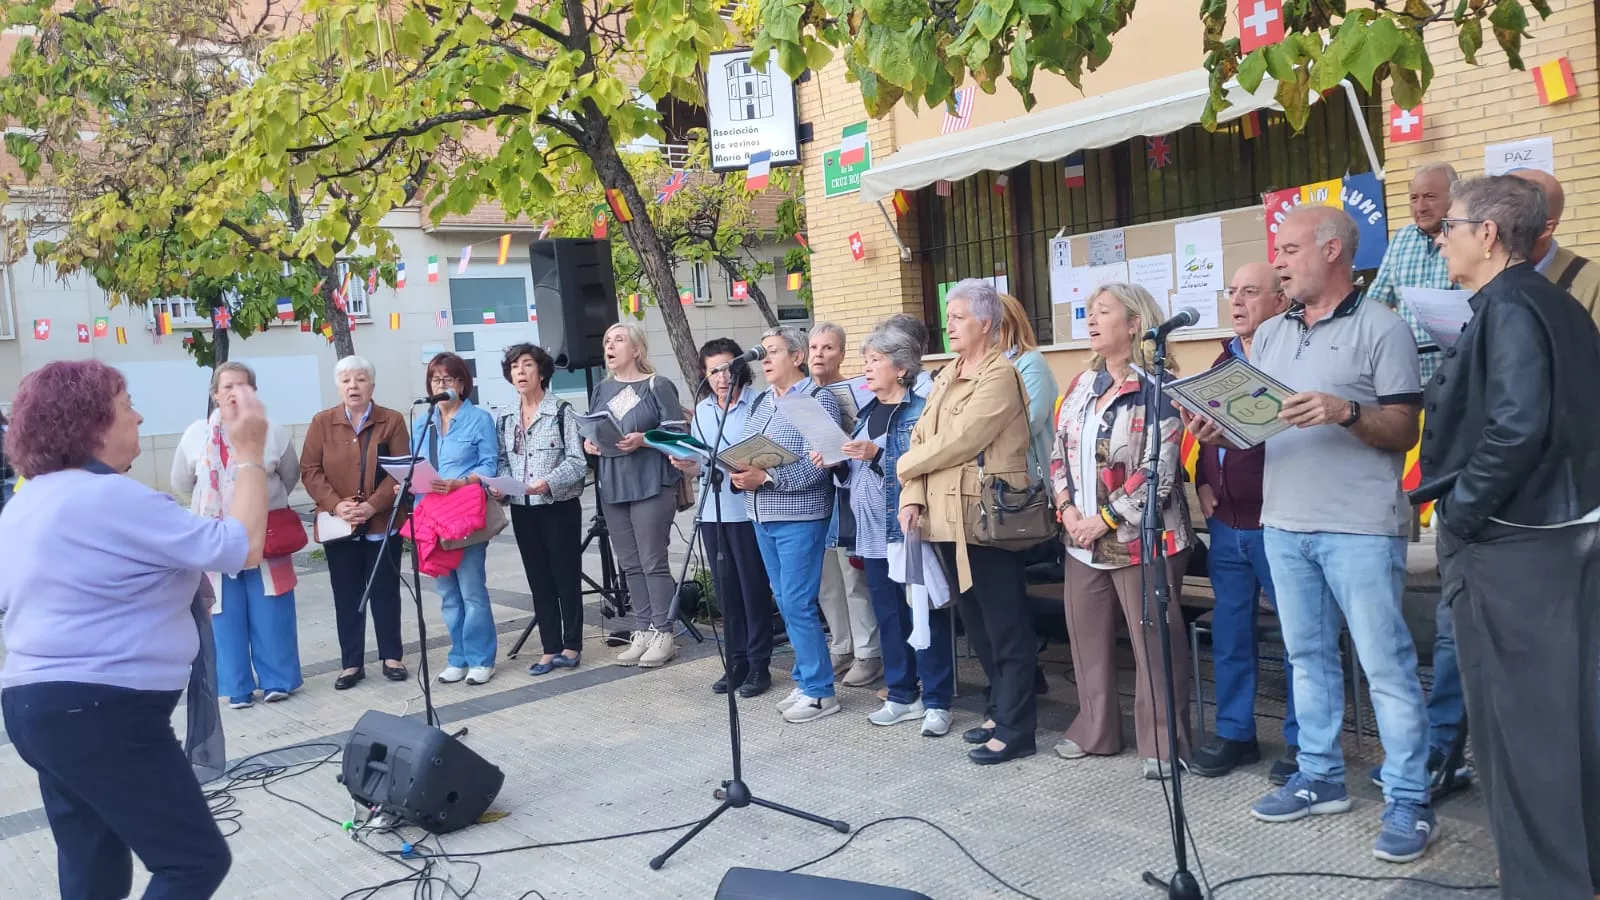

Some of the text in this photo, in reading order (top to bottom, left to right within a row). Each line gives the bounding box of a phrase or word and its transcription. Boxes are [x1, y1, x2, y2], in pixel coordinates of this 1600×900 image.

[713, 126, 759, 138] Asociación
[714, 140, 761, 150] de vecinos
[1504, 149, 1533, 163] PAZ
[832, 175, 848, 188] CRUZ
[1198, 373, 1244, 399] CORO
